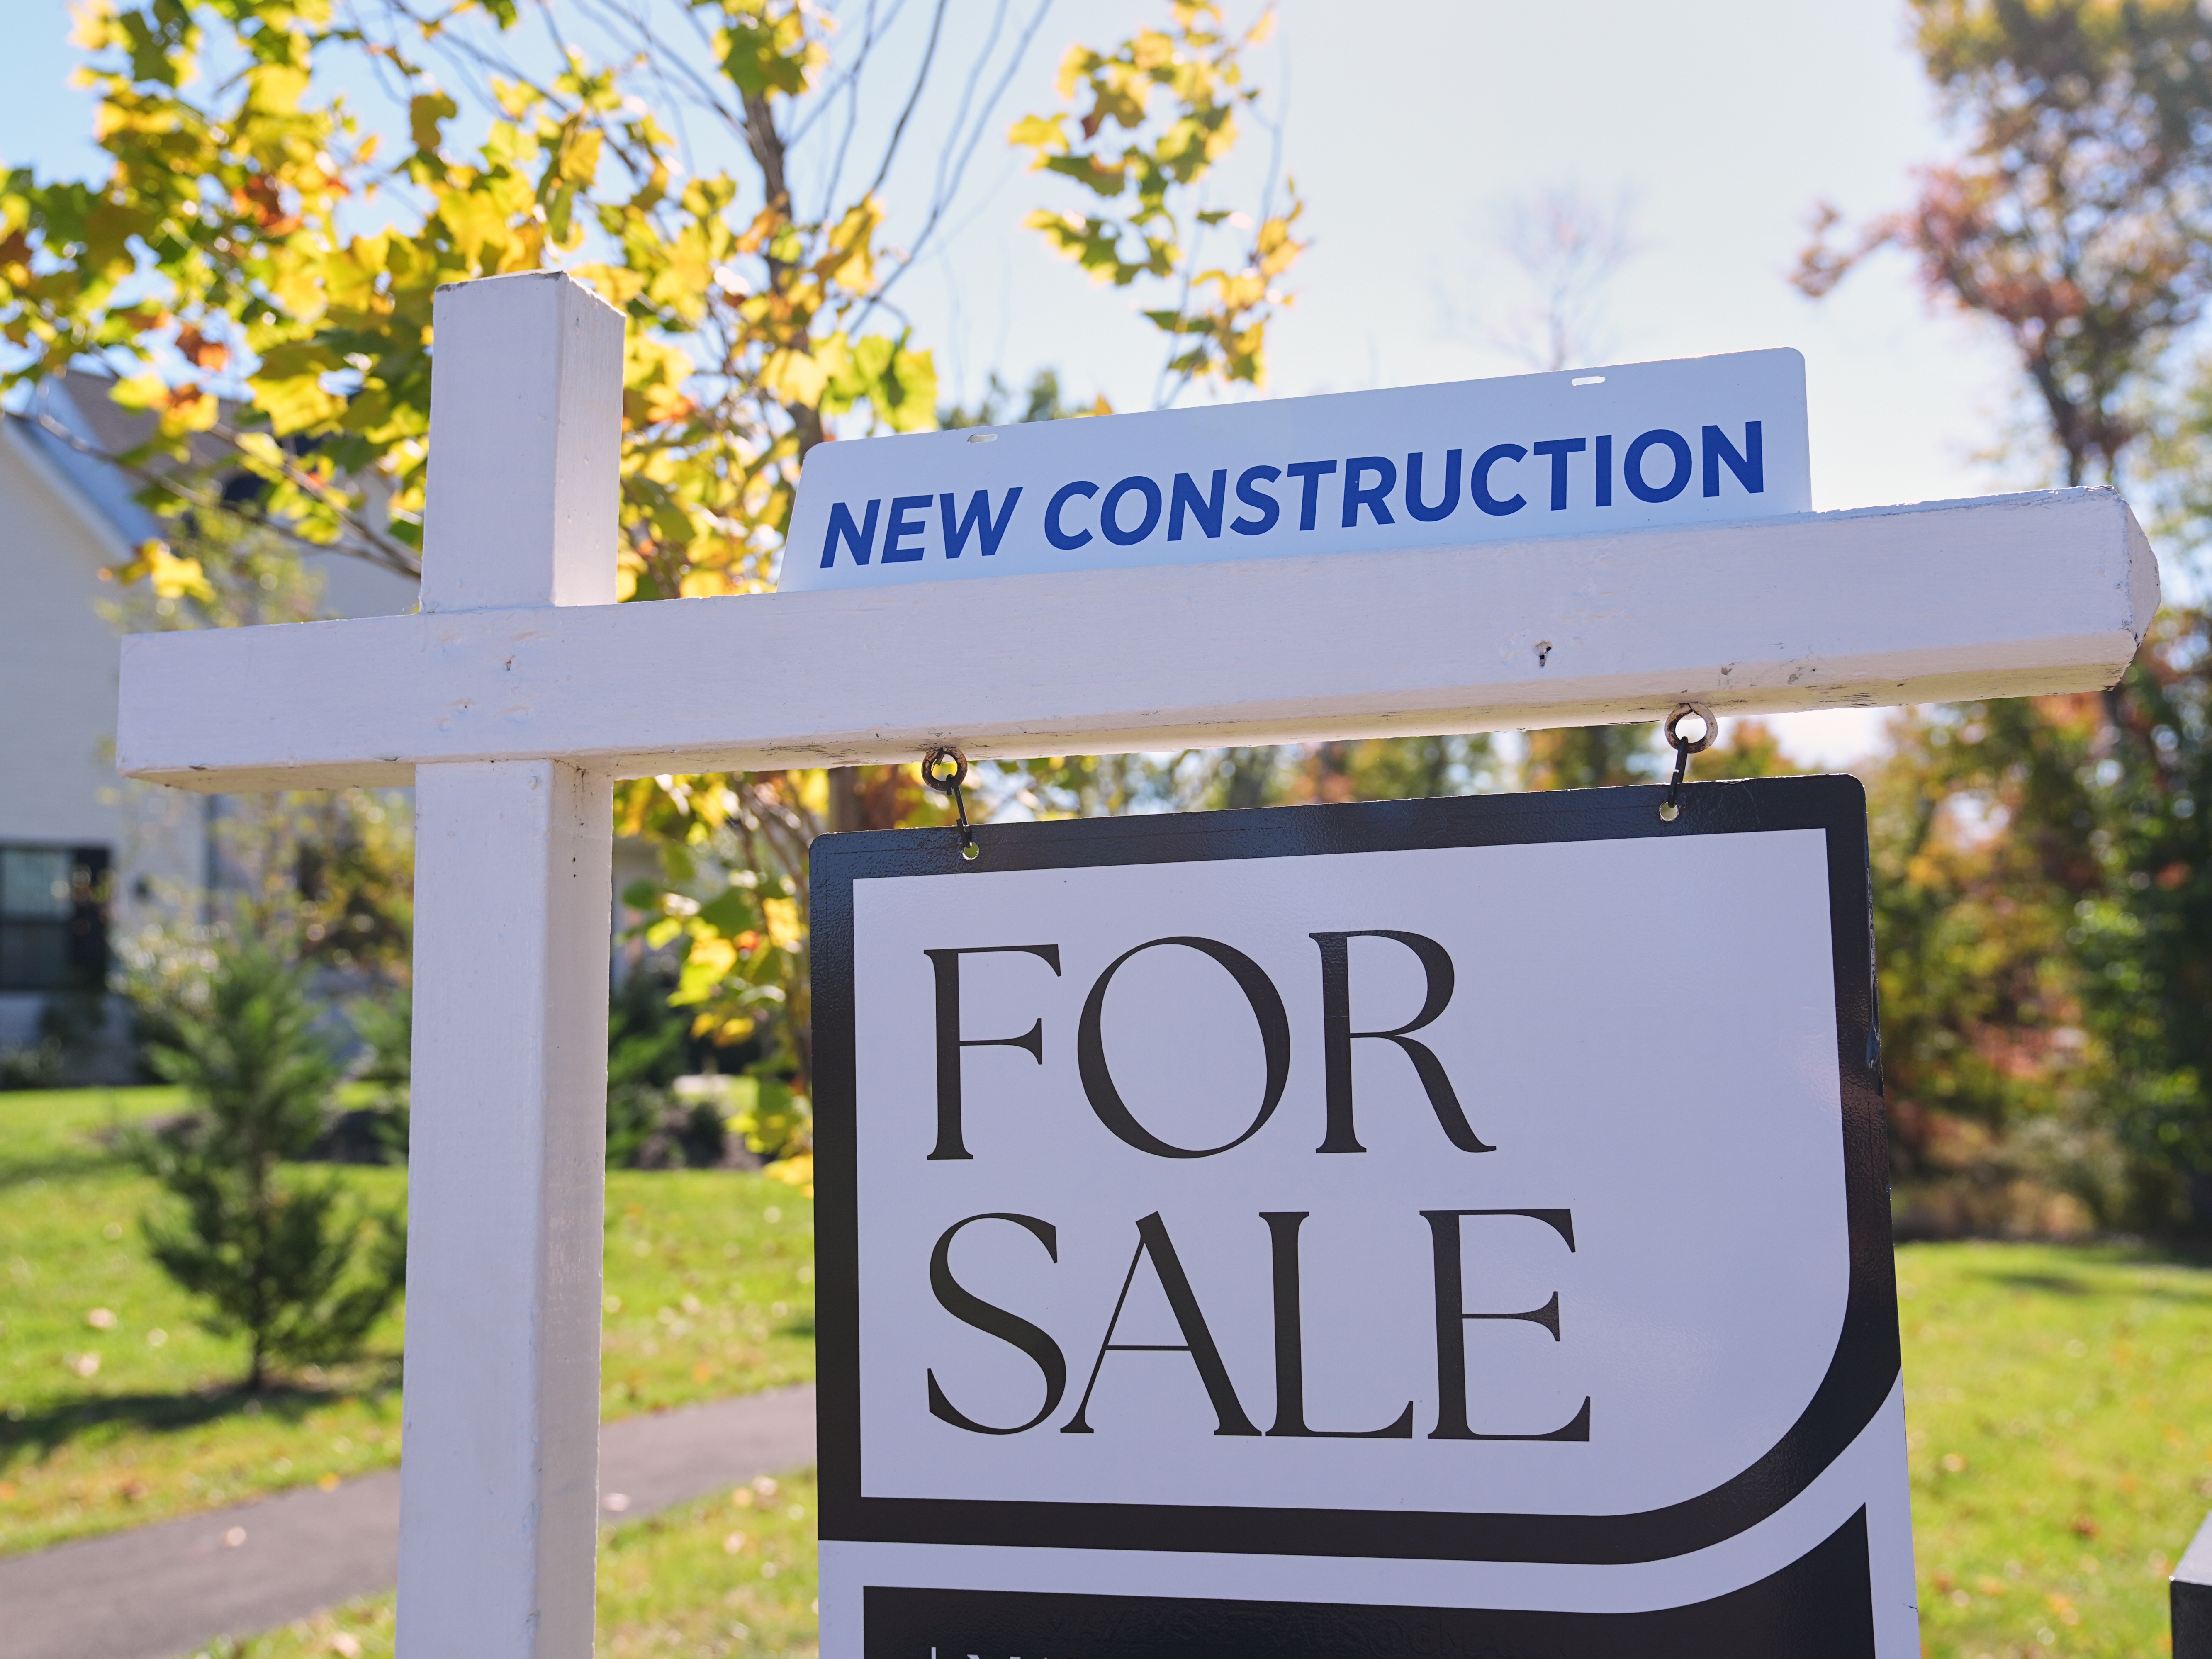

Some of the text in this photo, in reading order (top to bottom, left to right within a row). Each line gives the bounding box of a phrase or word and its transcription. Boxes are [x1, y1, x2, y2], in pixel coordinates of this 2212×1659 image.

[819, 420, 1764, 569] NEW CONSTRUCTION
[923, 929, 1497, 1160] FOR
[927, 1208, 1591, 1442] SALE
